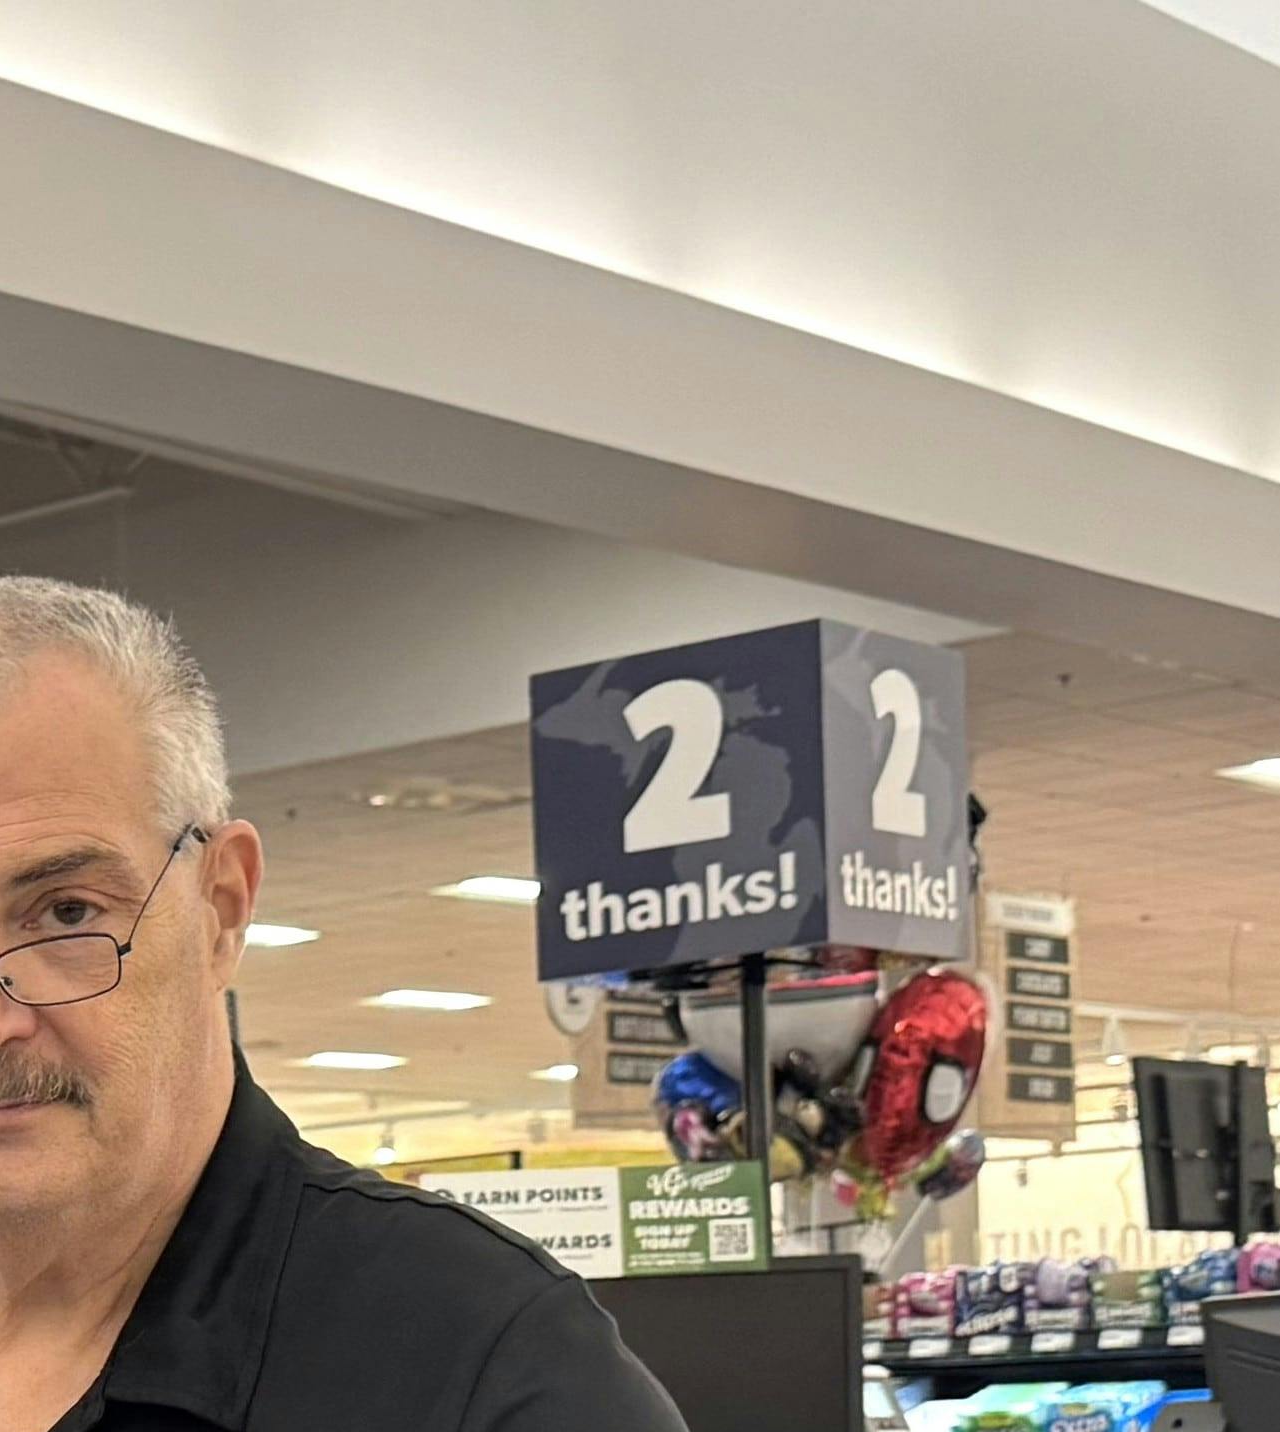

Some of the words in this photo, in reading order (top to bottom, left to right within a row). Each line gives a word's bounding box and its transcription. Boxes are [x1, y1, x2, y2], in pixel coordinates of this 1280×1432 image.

[622, 677, 731, 853] 2
[869, 667, 927, 838] 2
[560, 852, 798, 943] thanks!
[840, 852, 959, 922] thanks!
[525, 1186, 604, 1203] POINTS
[628, 1196, 751, 1220] REWARDS
